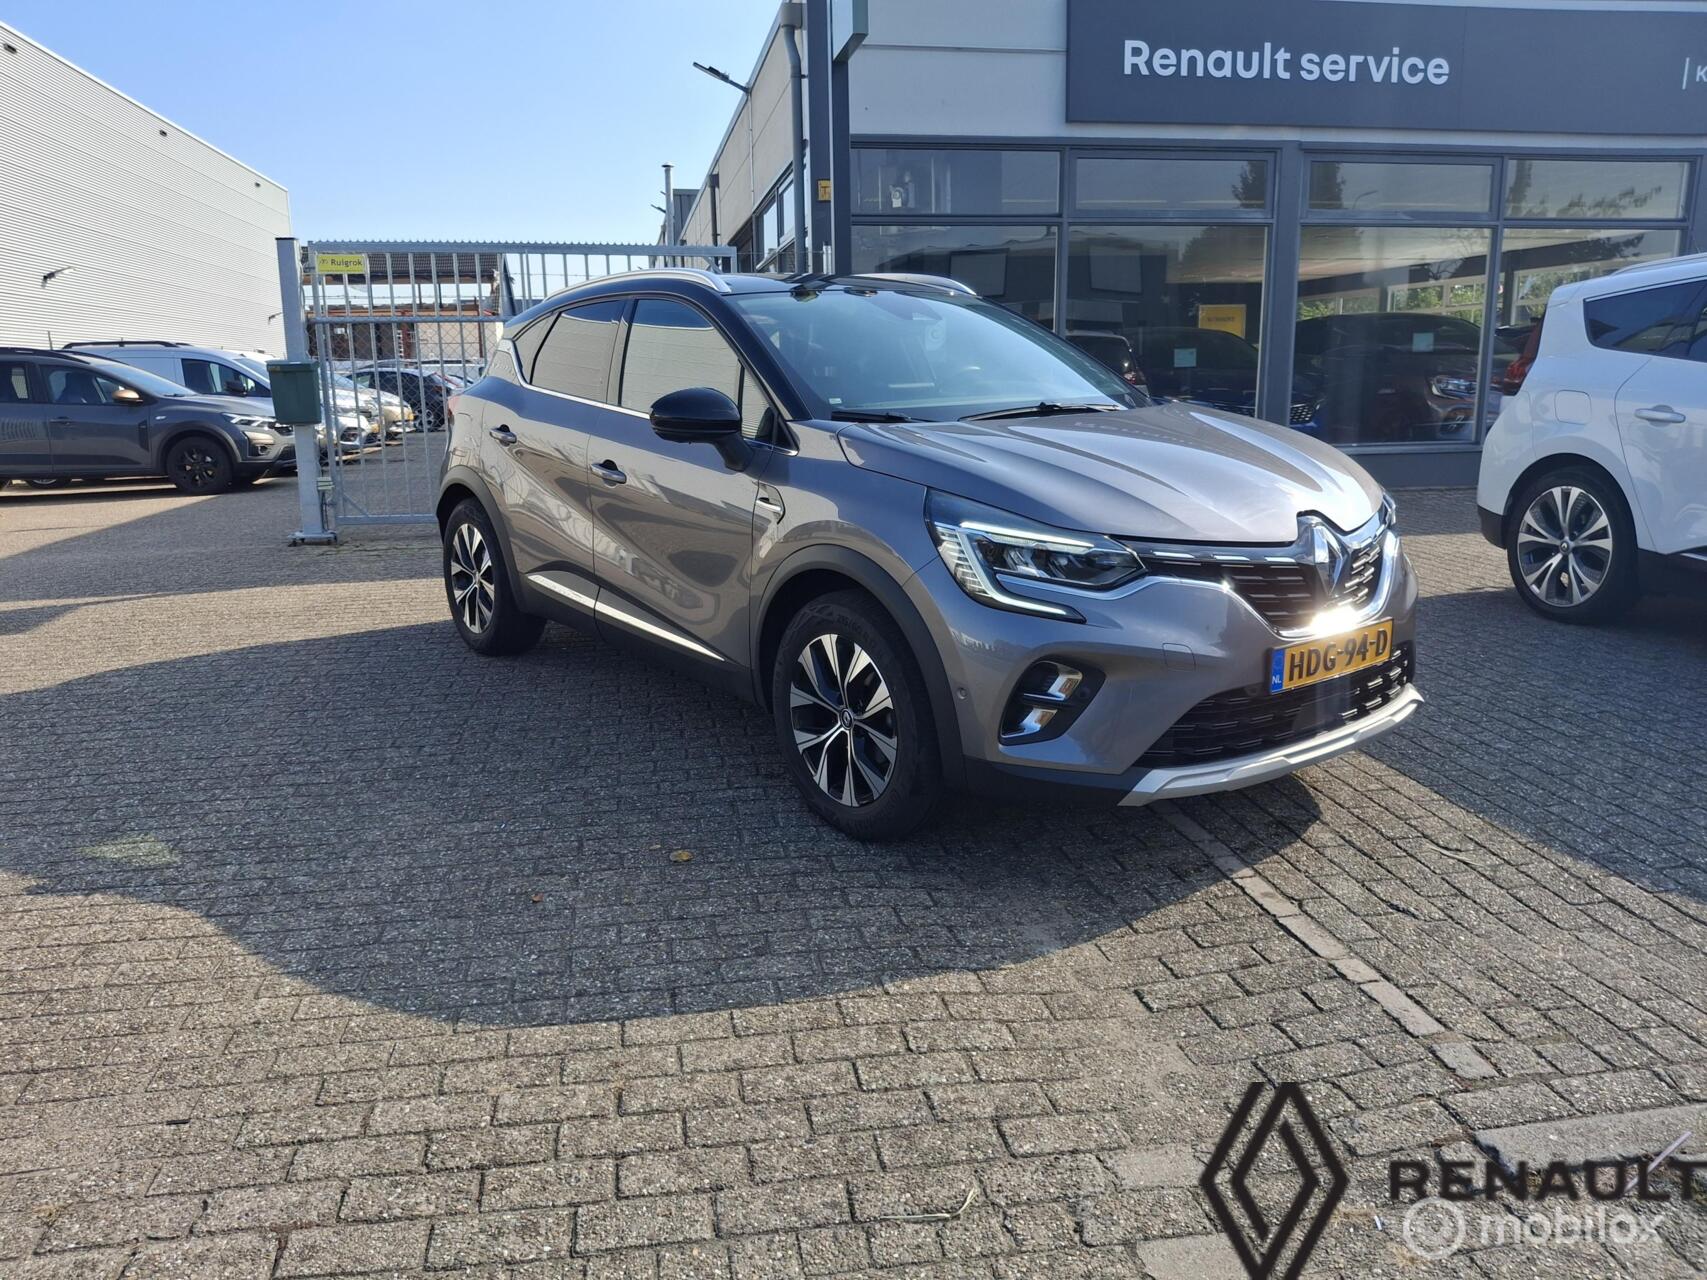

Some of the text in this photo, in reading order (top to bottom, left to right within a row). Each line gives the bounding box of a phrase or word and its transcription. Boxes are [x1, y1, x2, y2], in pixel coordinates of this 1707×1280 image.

[1123, 39, 1450, 85] Renault service
[1288, 628, 1388, 682] HDG-94-D
[1271, 674, 1282, 685] NL
